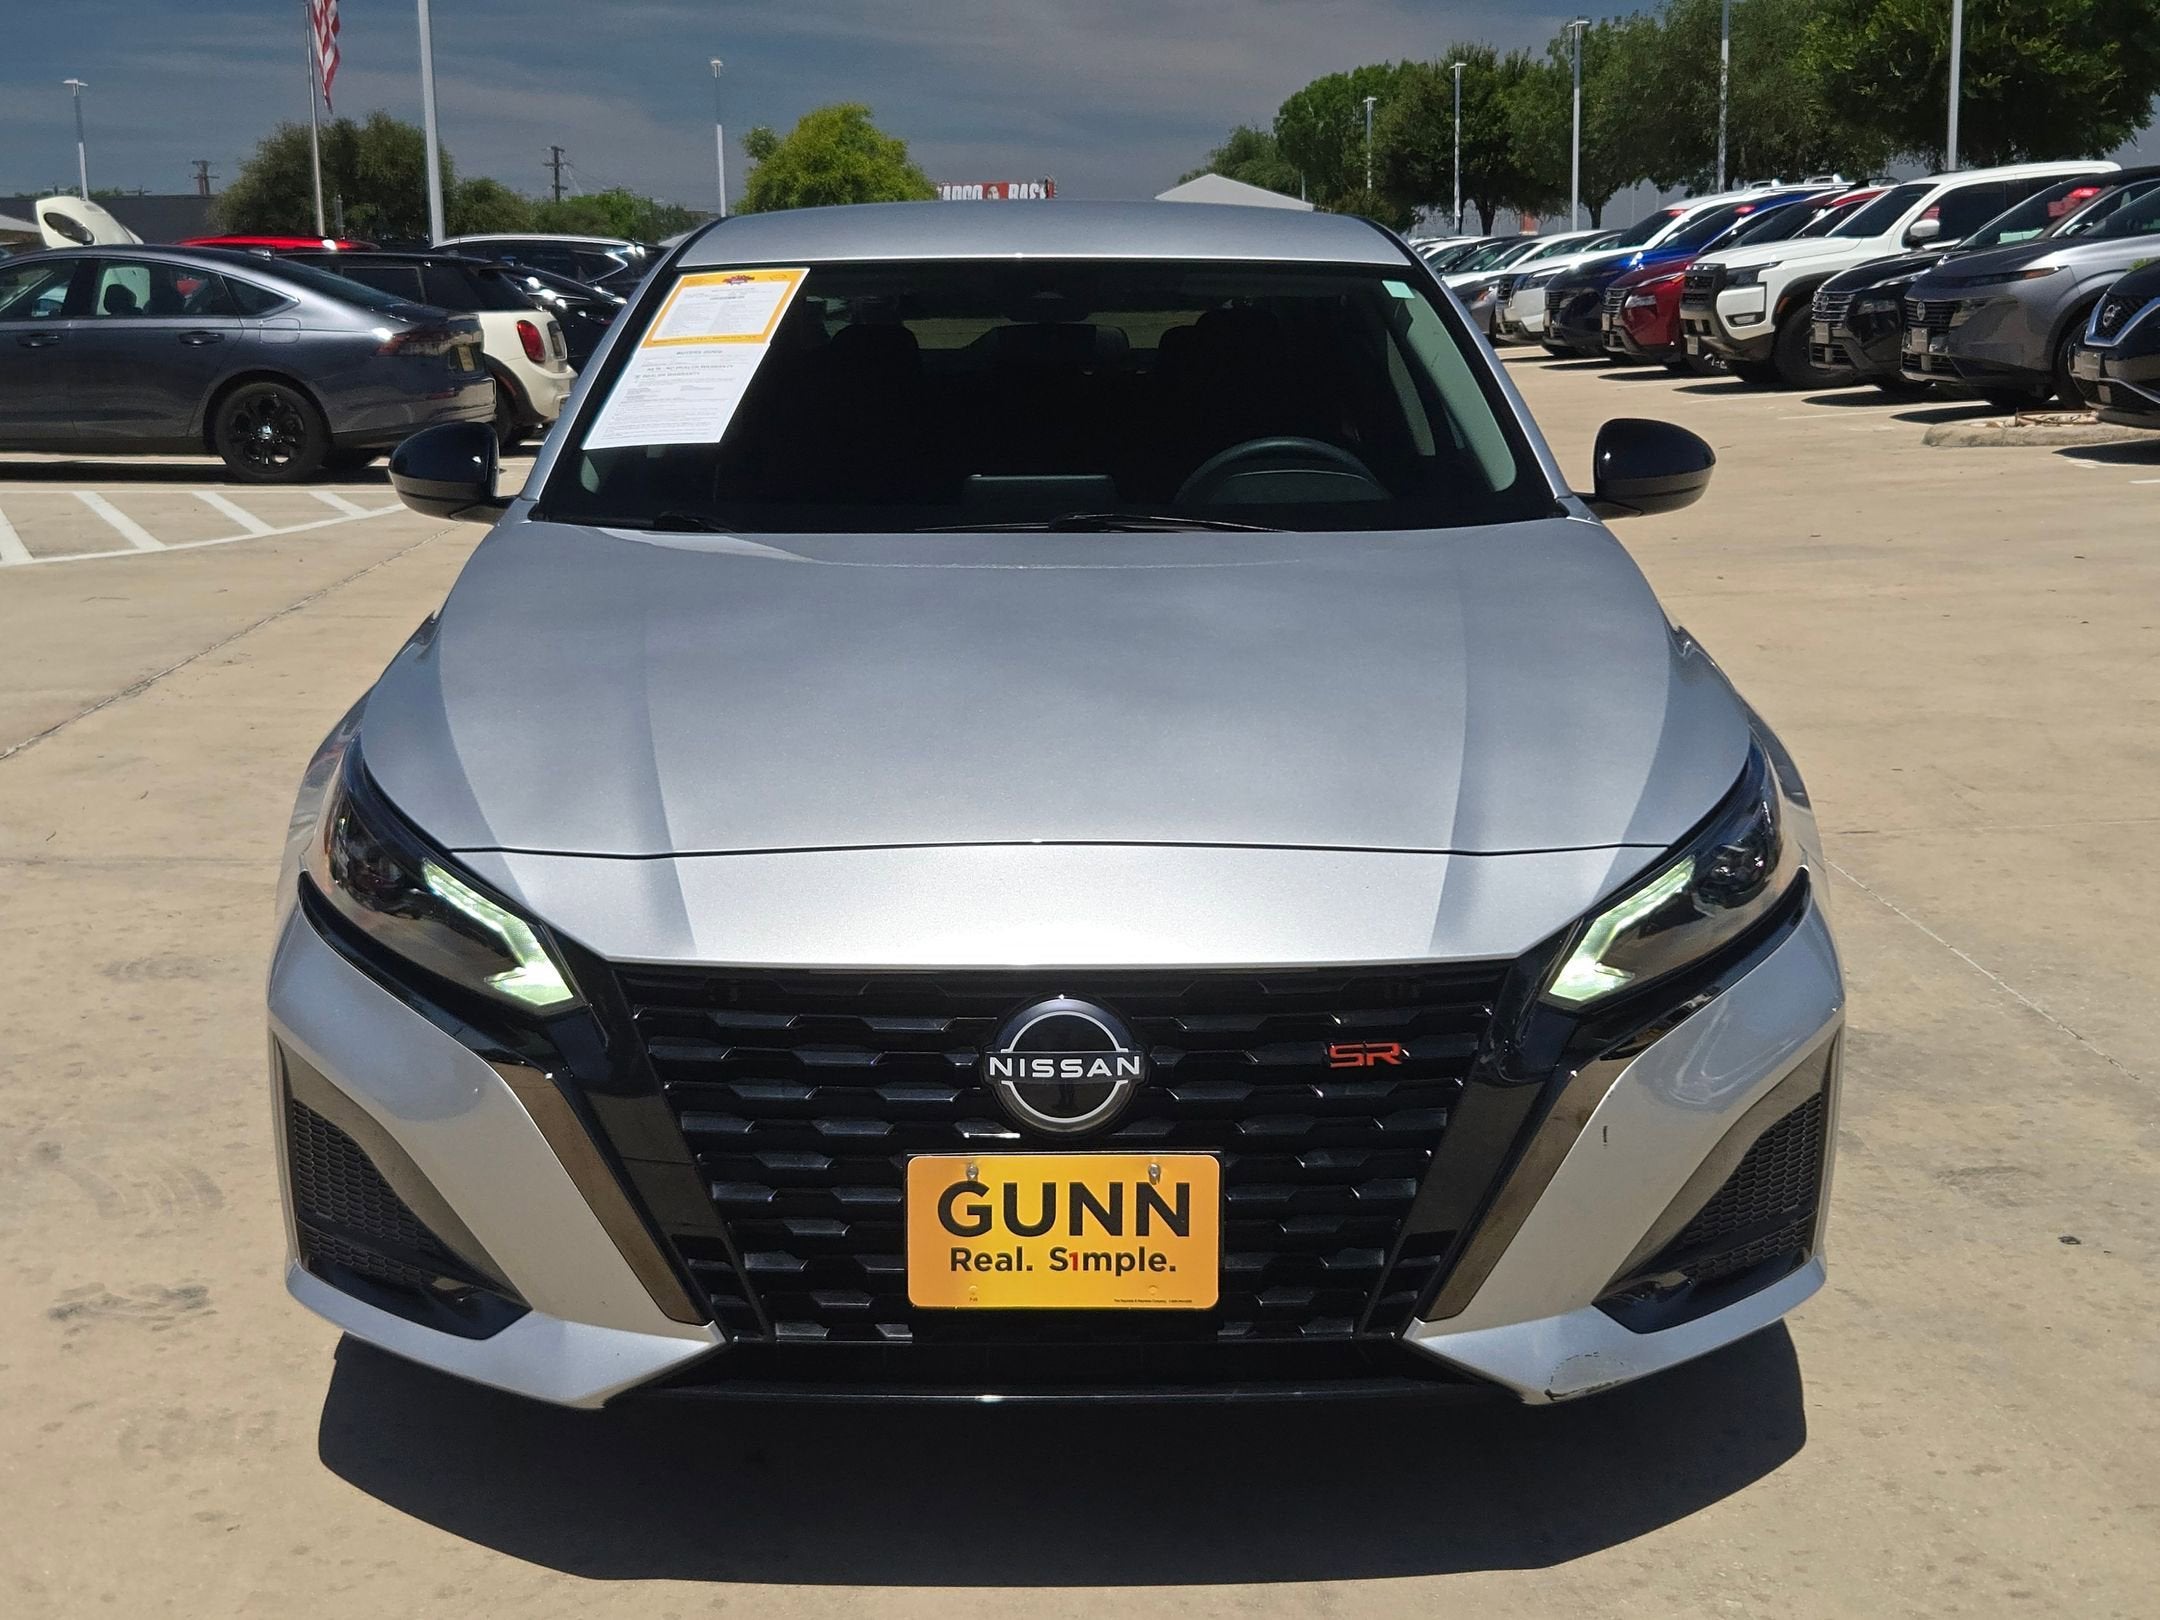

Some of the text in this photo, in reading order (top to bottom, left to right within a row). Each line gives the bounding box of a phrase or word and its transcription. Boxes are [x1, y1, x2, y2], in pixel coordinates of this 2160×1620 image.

[988, 1055, 1141, 1079] NISSAN
[1329, 1042, 1403, 1069] SR
[937, 1181, 1191, 1238] GUNN
[950, 1246, 1034, 1273] Real.
